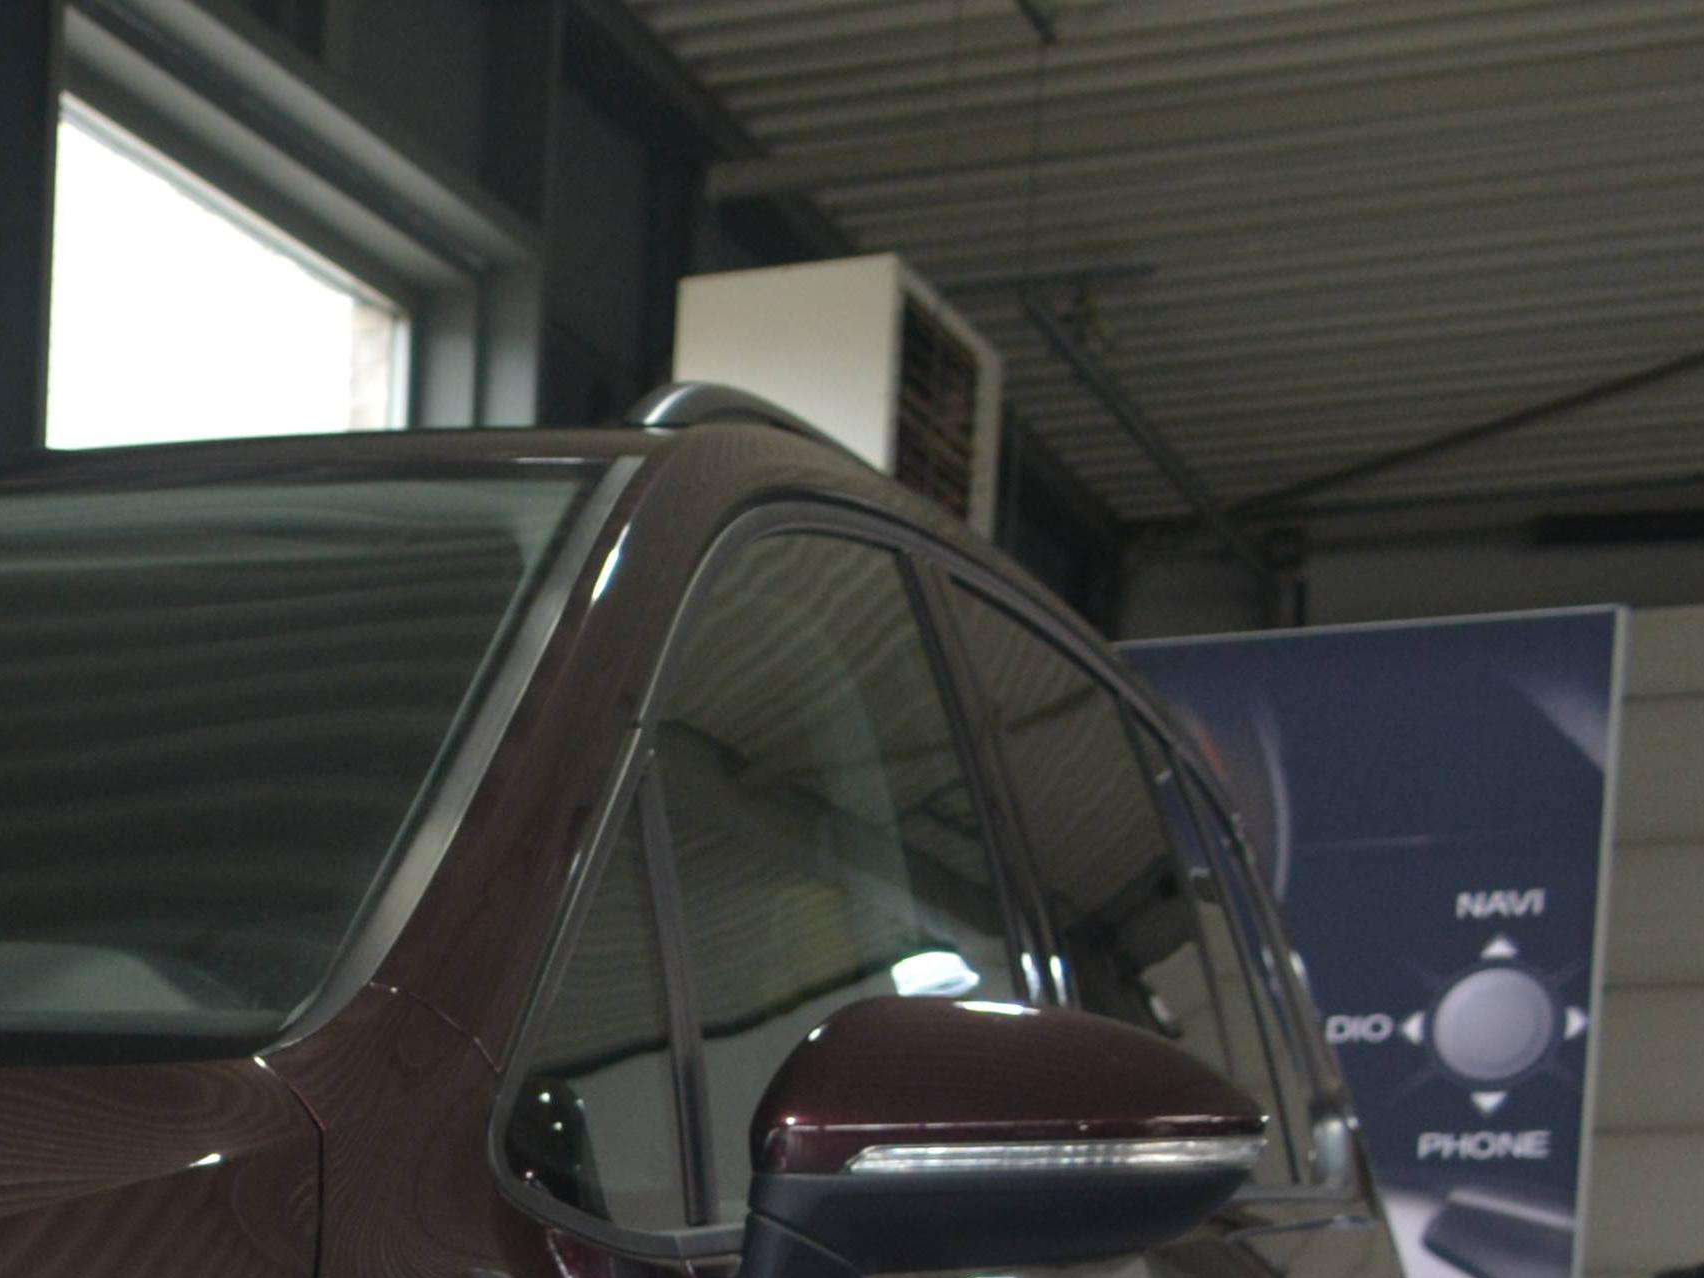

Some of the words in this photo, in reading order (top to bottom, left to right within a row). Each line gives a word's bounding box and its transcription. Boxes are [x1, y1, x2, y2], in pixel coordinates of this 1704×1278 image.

[1455, 887, 1546, 920] NAVI
[1325, 1013, 1393, 1044] DIO
[1416, 1128, 1552, 1160] PHONE
